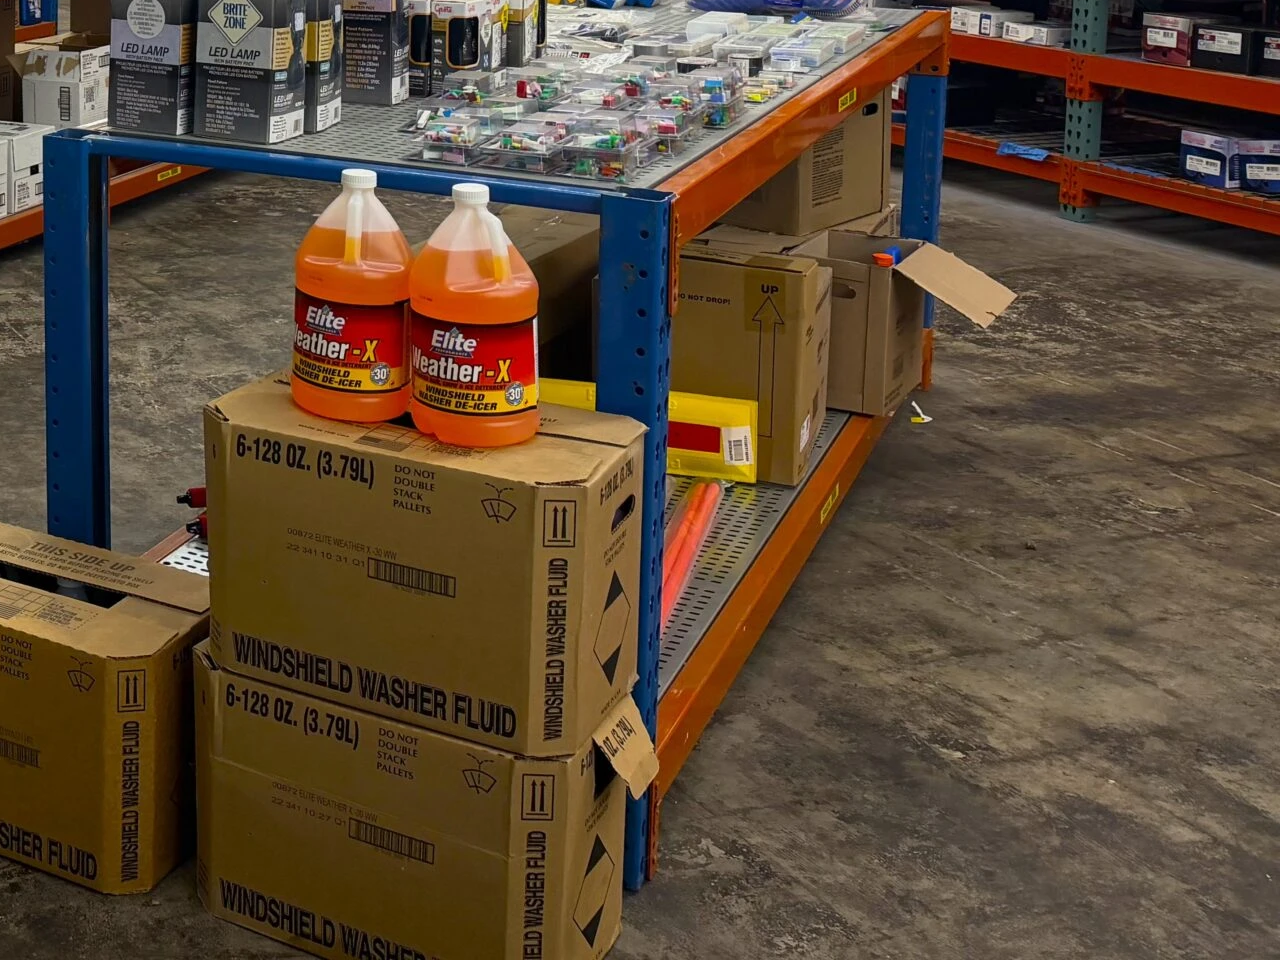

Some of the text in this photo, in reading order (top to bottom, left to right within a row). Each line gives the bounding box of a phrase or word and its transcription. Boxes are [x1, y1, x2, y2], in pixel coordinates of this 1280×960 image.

[223, 2, 248, 17] BRITE
[224, 17, 247, 30] ZONE
[121, 43, 169, 57] LED LAMP
[209, 46, 261, 61] LED LAMP
[760, 283, 779, 294] UP
[688, 294, 731, 306] NOT DROP!
[306, 305, 346, 331] Elite
[431, 329, 478, 353] Elite
[299, 357, 350, 378] WINDSHIELD
[412, 344, 511, 383] Weather -X
[321, 374, 362, 389] DE-ICER
[425, 384, 485, 402] WINDSHIELD
[454, 398, 497, 411] DE-ICER
[236, 433, 375, 490] 6-128 OZ. (3.79L)
[395, 464, 436, 480] DO NOT
[394, 476, 436, 491] DOUBLE
[393, 487, 423, 501] STACK
[393, 499, 432, 515] PALLETS
[287, 527, 314, 540] 00872
[314, 533, 332, 545] ELITE
[333, 536, 365, 553] WEATHER
[30, 541, 136, 574] THIS SIDE UP
[301, 546, 318, 557] 341
[0, 633, 33, 651] DO NOT
[543, 557, 568, 742] WINDSHIELD WASHER FLUID
[0, 644, 33, 662] DOUBLE
[0, 655, 24, 669] STACK
[0, 665, 30, 681] PALLETS
[231, 631, 353, 694] WINDSHIELD
[356, 666, 449, 721] WASHER
[452, 692, 517, 739] FLUID
[225, 683, 360, 751] 6-128 OZ. (3.79L)
[379, 727, 419, 746] DO NOT
[378, 739, 419, 758] DOUBLE
[377, 750, 407, 766] STACK
[376, 762, 414, 780] PALLETS
[121, 720, 139, 883] WINDSHIELD WASHER FLUID
[527, 831, 547, 867] FLUID
[47, 838, 98, 882] FLUID
[525, 868, 545, 928] WASHER
[219, 876, 336, 949] WINDSHIELD
